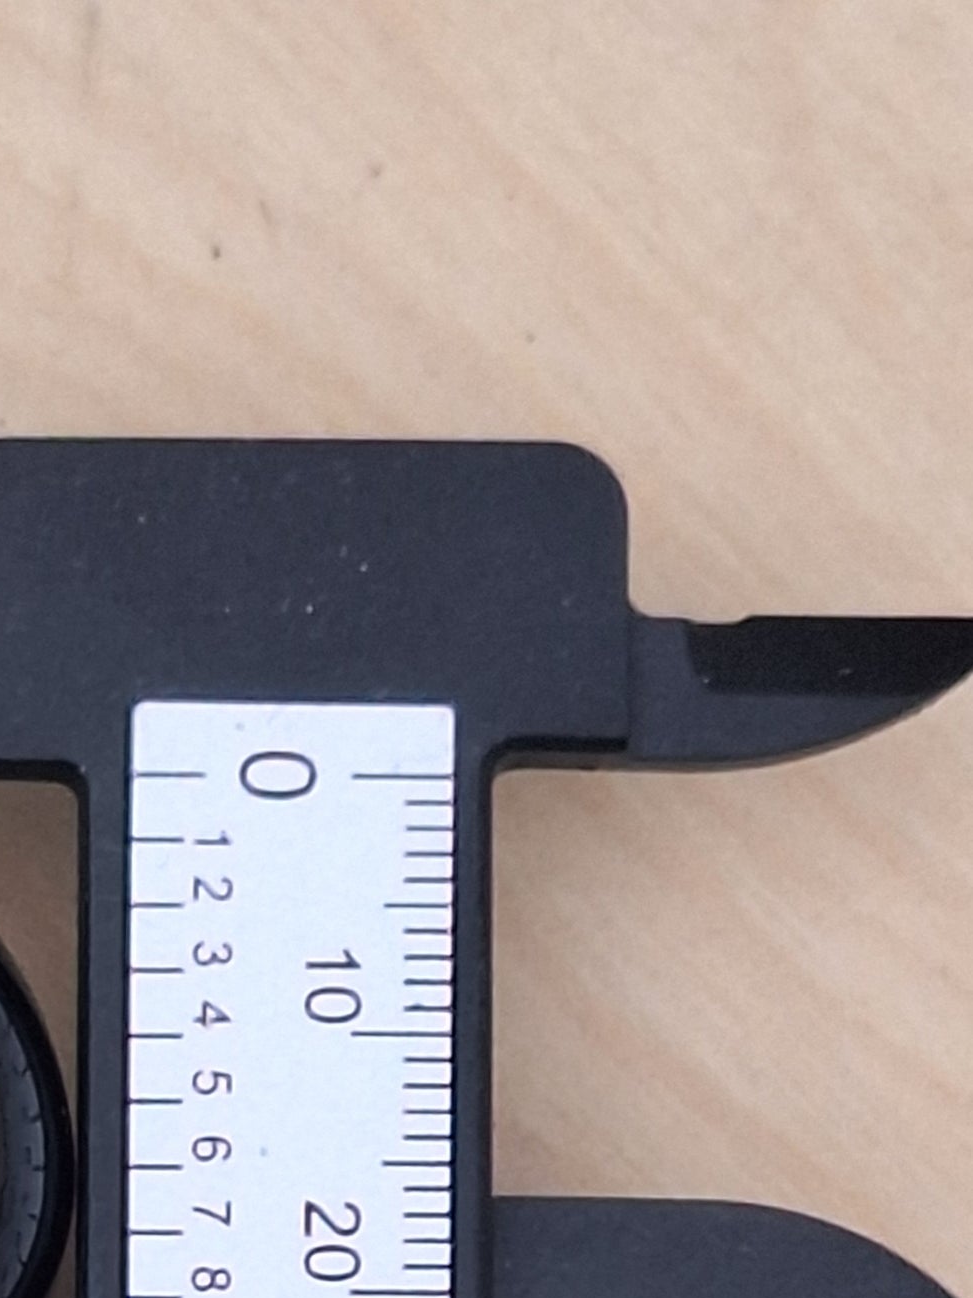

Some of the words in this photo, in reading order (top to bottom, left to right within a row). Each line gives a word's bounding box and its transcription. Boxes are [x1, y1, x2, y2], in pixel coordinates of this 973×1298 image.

[239, 750, 318, 800] 0
[193, 830, 231, 846] 1
[192, 876, 233, 902] 2
[192, 941, 233, 967] 3
[304, 949, 362, 1024] 10
[193, 1000, 232, 1028] 4
[191, 1069, 233, 1096] 5
[191, 1135, 232, 1163] 6
[192, 1200, 231, 1226] 7
[303, 1200, 362, 1282] 20
[190, 1266, 232, 1293] 8
